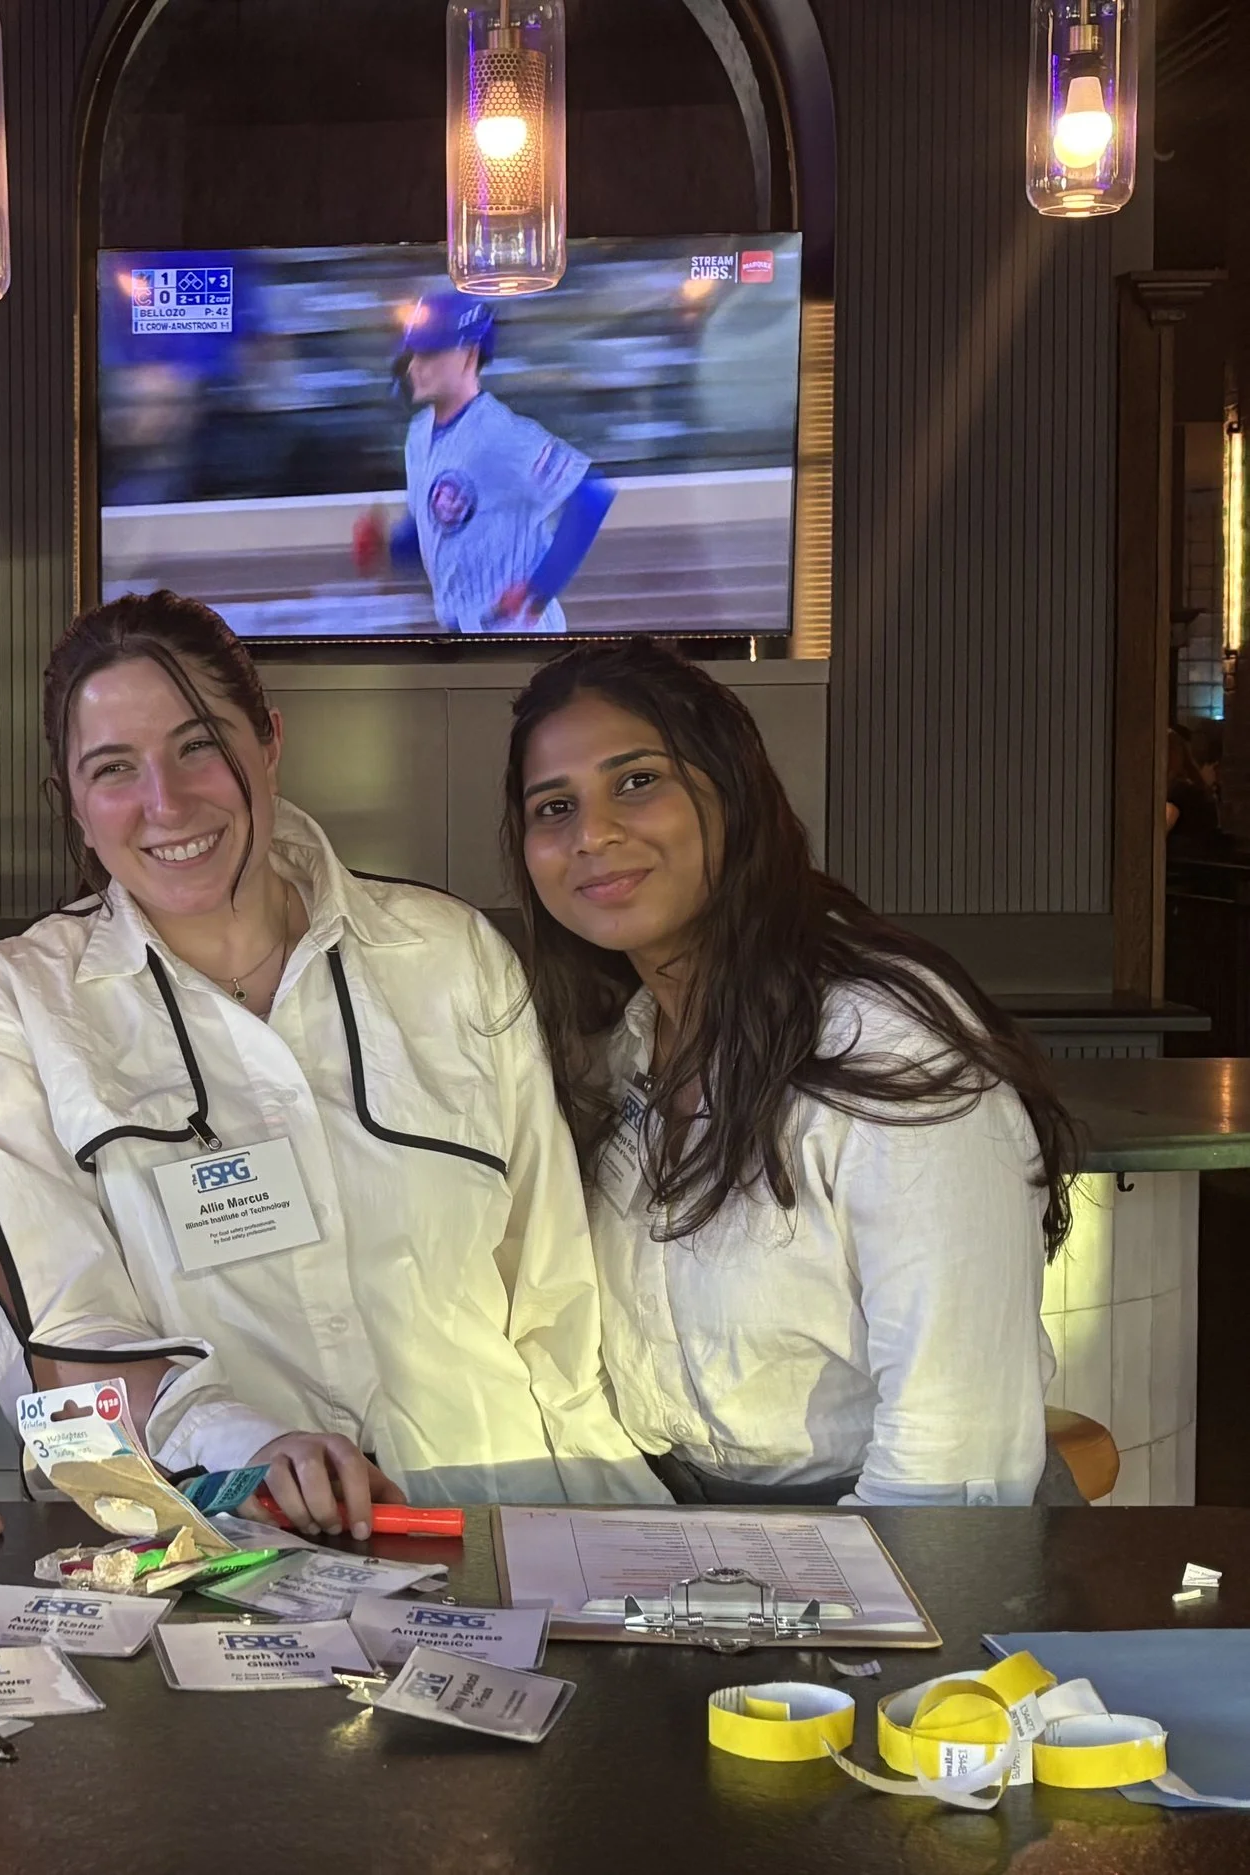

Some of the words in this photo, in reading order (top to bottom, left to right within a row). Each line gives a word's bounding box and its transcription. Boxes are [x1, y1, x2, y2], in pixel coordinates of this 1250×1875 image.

[691, 255, 734, 267] STREAM
[161, 272, 168, 286] 1
[690, 266, 732, 280] CUBS.
[219, 274, 228, 288] 3
[159, 290, 170, 304] 0
[179, 295, 201, 303] 2-1
[139, 308, 186, 318] BELLOZO
[215, 307, 229, 316] 42
[196, 1158, 251, 1190] FSPG
[199, 1202, 225, 1216] Allie
[226, 1190, 270, 1209] Marcus
[185, 1219, 209, 1231] Illinois
[210, 1212, 240, 1225] Institute
[240, 1209, 249, 1218] of
[249, 1200, 291, 1216] Technology
[32, 1439, 49, 1458] 3
[414, 1609, 487, 1629] FSPG
[225, 1633, 300, 1650] FSPG
[391, 1626, 449, 1640] Andrea
[452, 1631, 503, 1643] Anase
[416, 1637, 474, 1648] PepsiCo
[224, 1651, 271, 1662] Sarah
[273, 1650, 316, 1660] Yang
